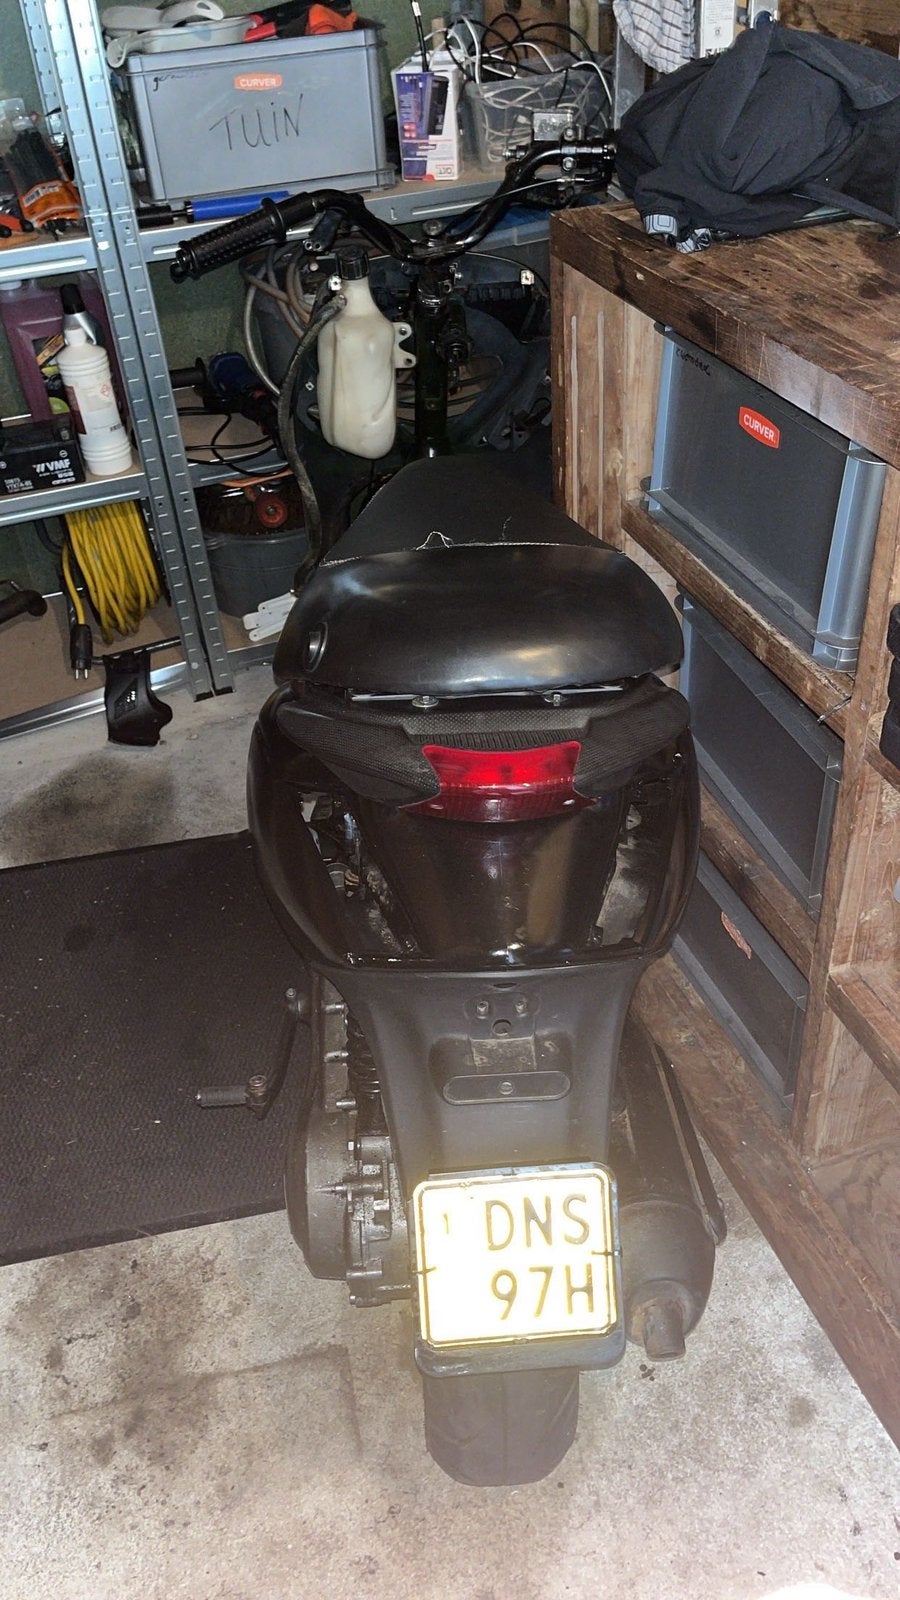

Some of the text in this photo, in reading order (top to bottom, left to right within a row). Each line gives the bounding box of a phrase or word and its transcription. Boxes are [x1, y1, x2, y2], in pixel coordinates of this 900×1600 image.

[239, 78, 276, 88] CURVER
[743, 414, 775, 442] CURVER
[485, 1193, 590, 1251] DNS
[491, 1263, 594, 1321] 97H
